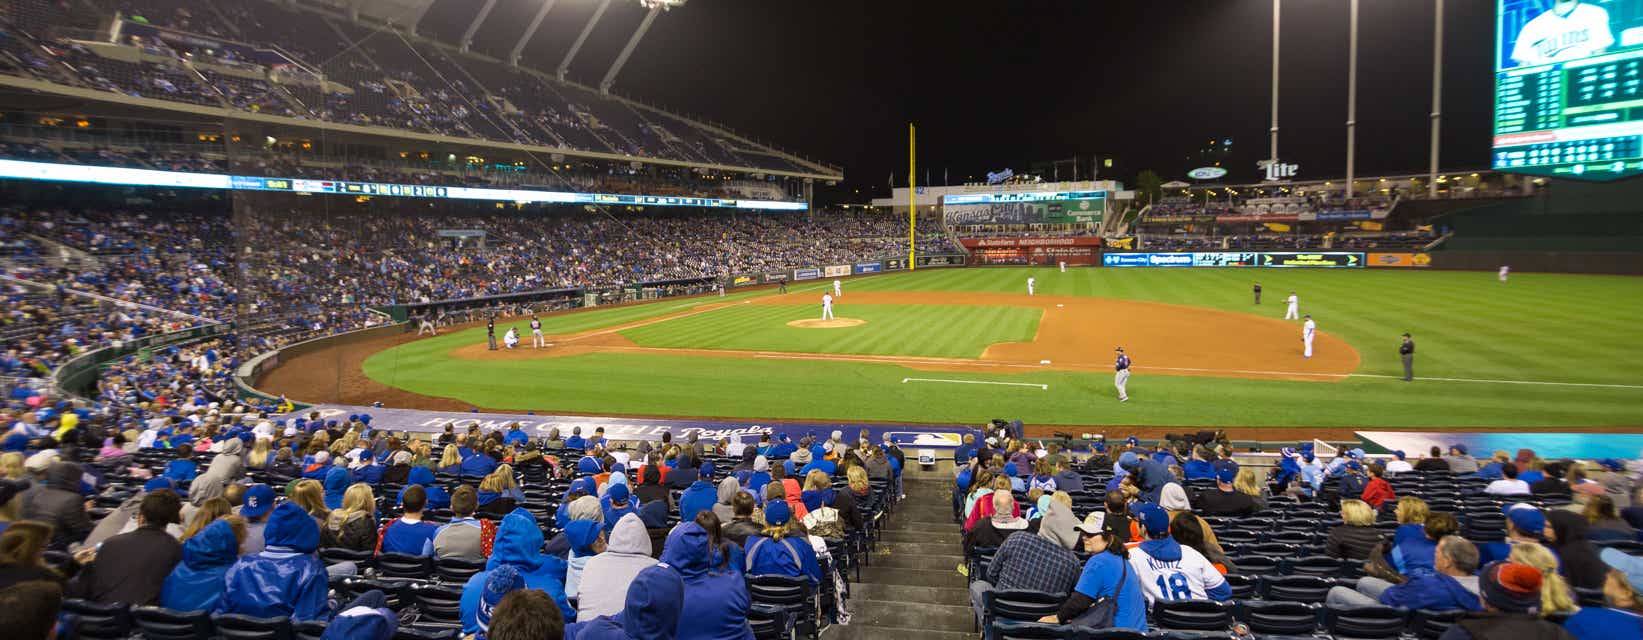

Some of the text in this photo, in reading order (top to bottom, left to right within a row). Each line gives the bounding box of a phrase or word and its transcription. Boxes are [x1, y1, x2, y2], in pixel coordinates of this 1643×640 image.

[1265, 162, 1299, 180] Lite
[1150, 255, 1193, 265] Spectrum
[676, 424, 774, 441] Royals
[1156, 571, 1193, 601] 18
